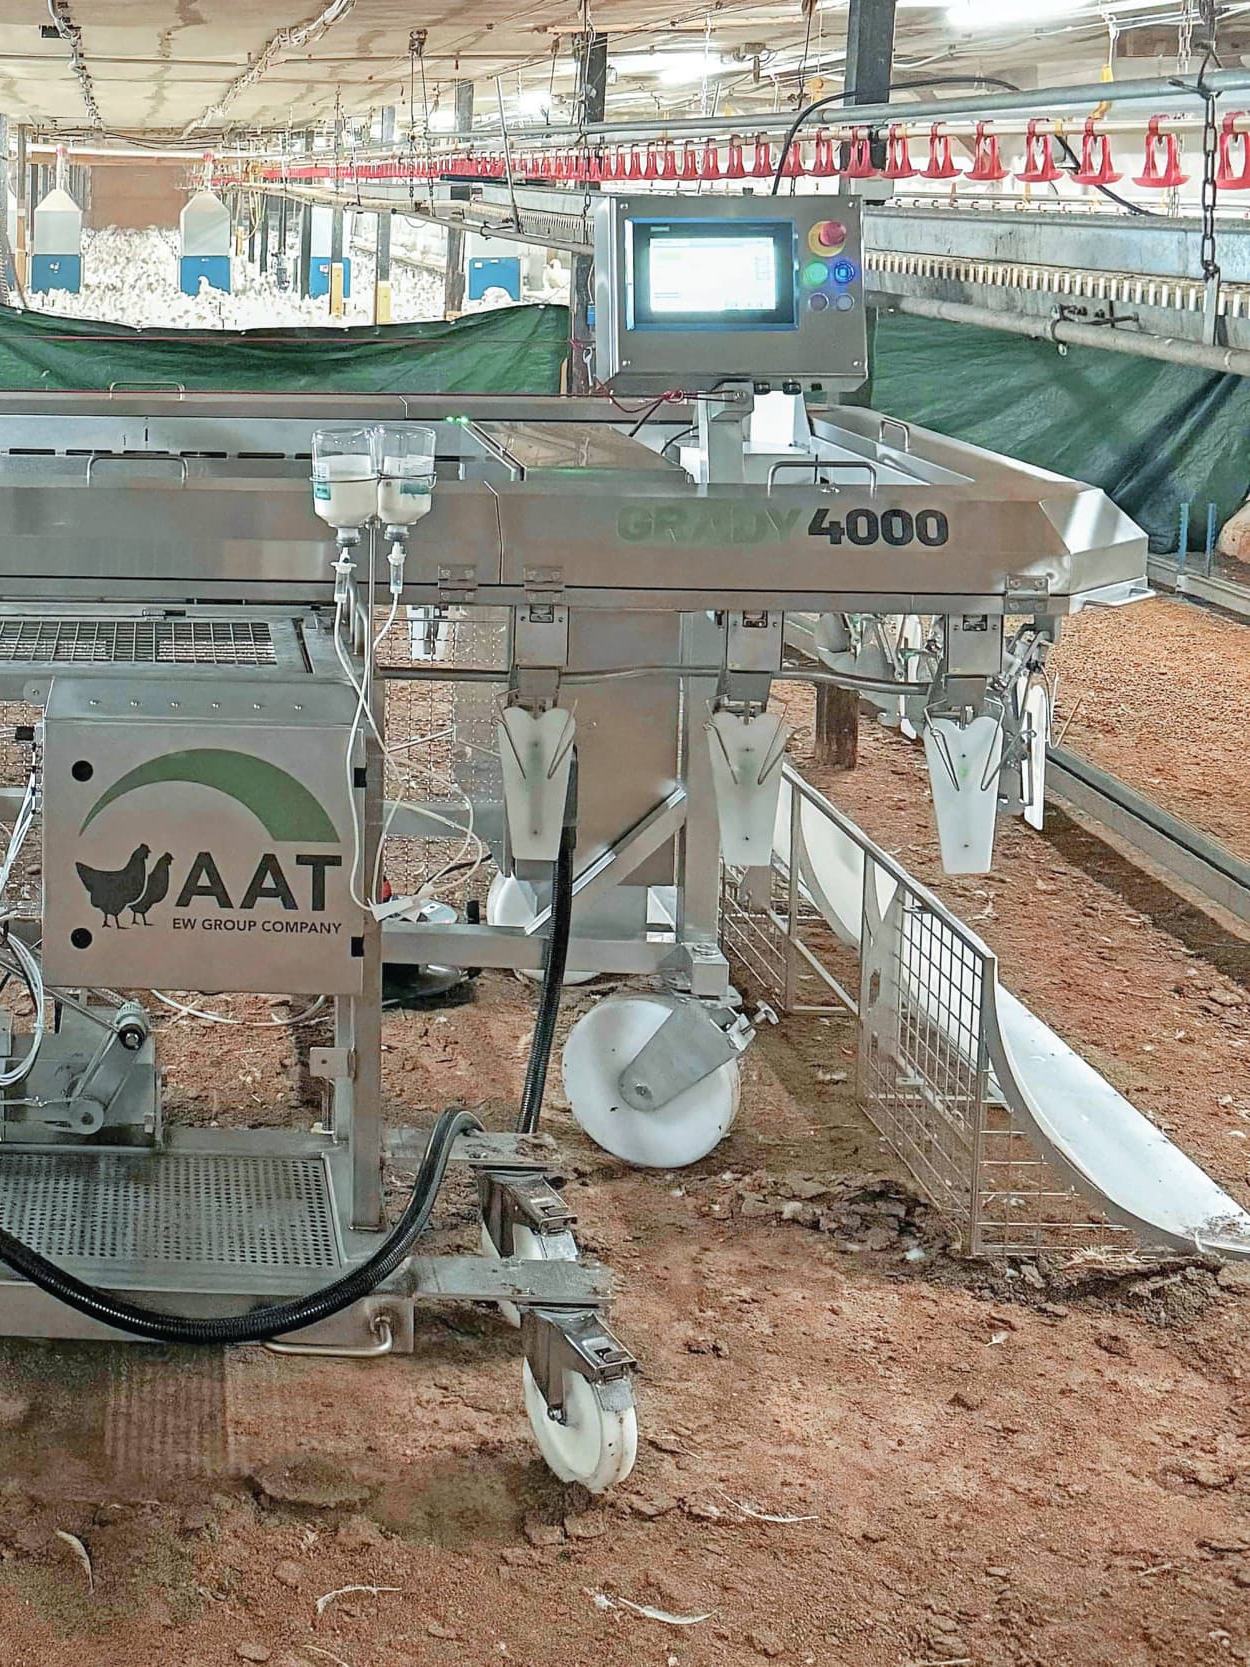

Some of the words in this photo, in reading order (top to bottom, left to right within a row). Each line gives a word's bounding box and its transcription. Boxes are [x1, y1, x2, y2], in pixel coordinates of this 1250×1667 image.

[616, 505, 802, 544] GRADY
[807, 507, 950, 547] 4000
[175, 851, 343, 911] AAT
[172, 917, 197, 930] EW
[201, 918, 257, 932] GROUP
[261, 920, 342, 935] COMPANY
